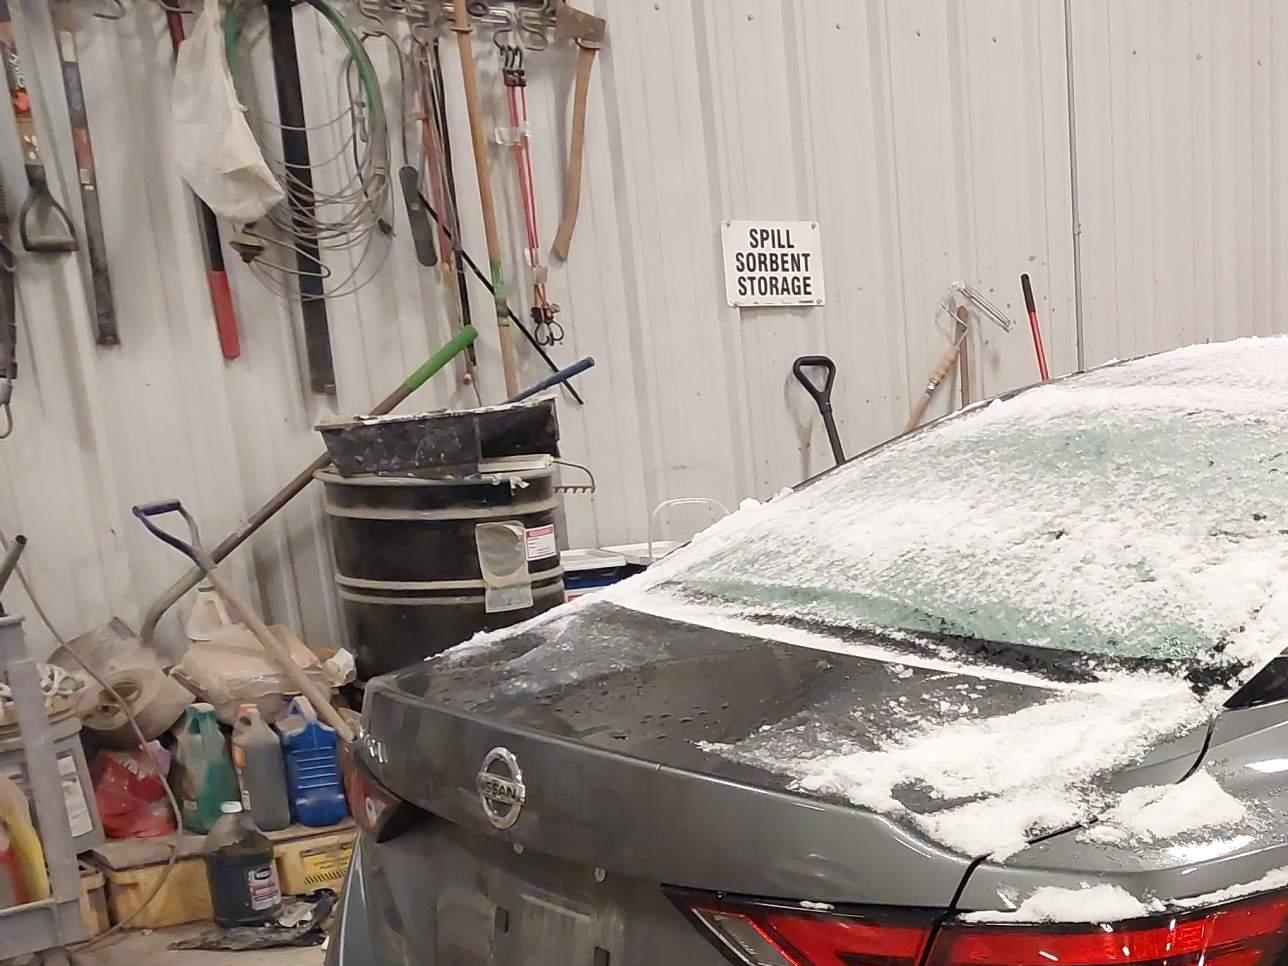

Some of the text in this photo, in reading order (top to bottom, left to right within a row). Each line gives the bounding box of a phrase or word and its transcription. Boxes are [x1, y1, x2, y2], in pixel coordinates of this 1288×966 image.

[749, 228, 795, 249] SPILL
[735, 252, 811, 272] SORBENT
[738, 276, 812, 296] STORAGE
